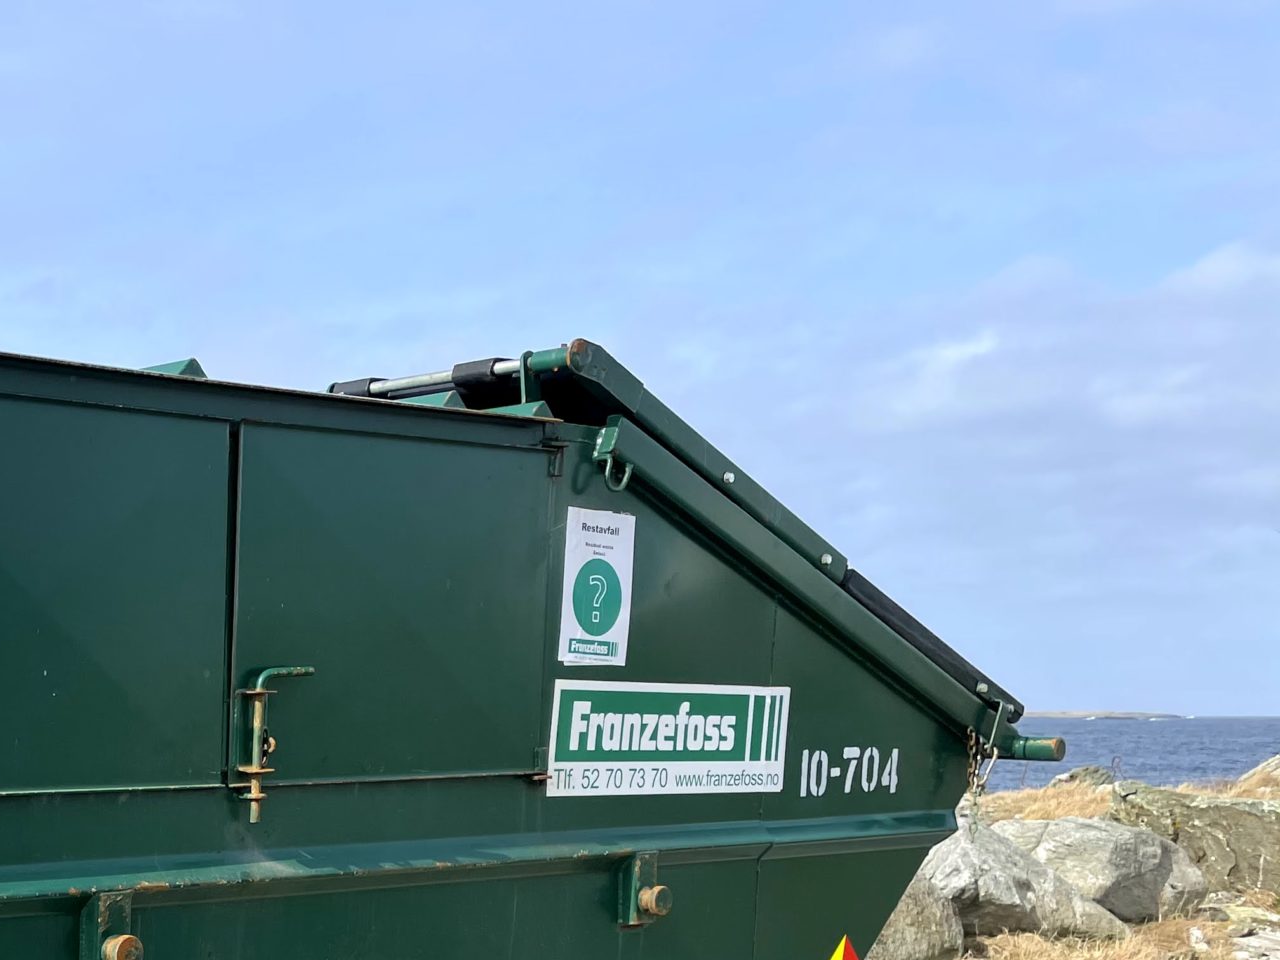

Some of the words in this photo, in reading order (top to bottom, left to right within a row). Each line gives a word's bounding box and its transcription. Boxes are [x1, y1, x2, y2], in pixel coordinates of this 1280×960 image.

[581, 522, 620, 536] Restavfall
[569, 700, 737, 751] Franzefoss
[554, 768, 576, 791] Tlf.
[581, 768, 600, 790] 52
[605, 768, 624, 789] 70
[628, 768, 647, 789] 73
[650, 767, 669, 788] 70
[674, 768, 780, 790] www.franzefoss.no
[799, 746, 900, 798] 10-704
